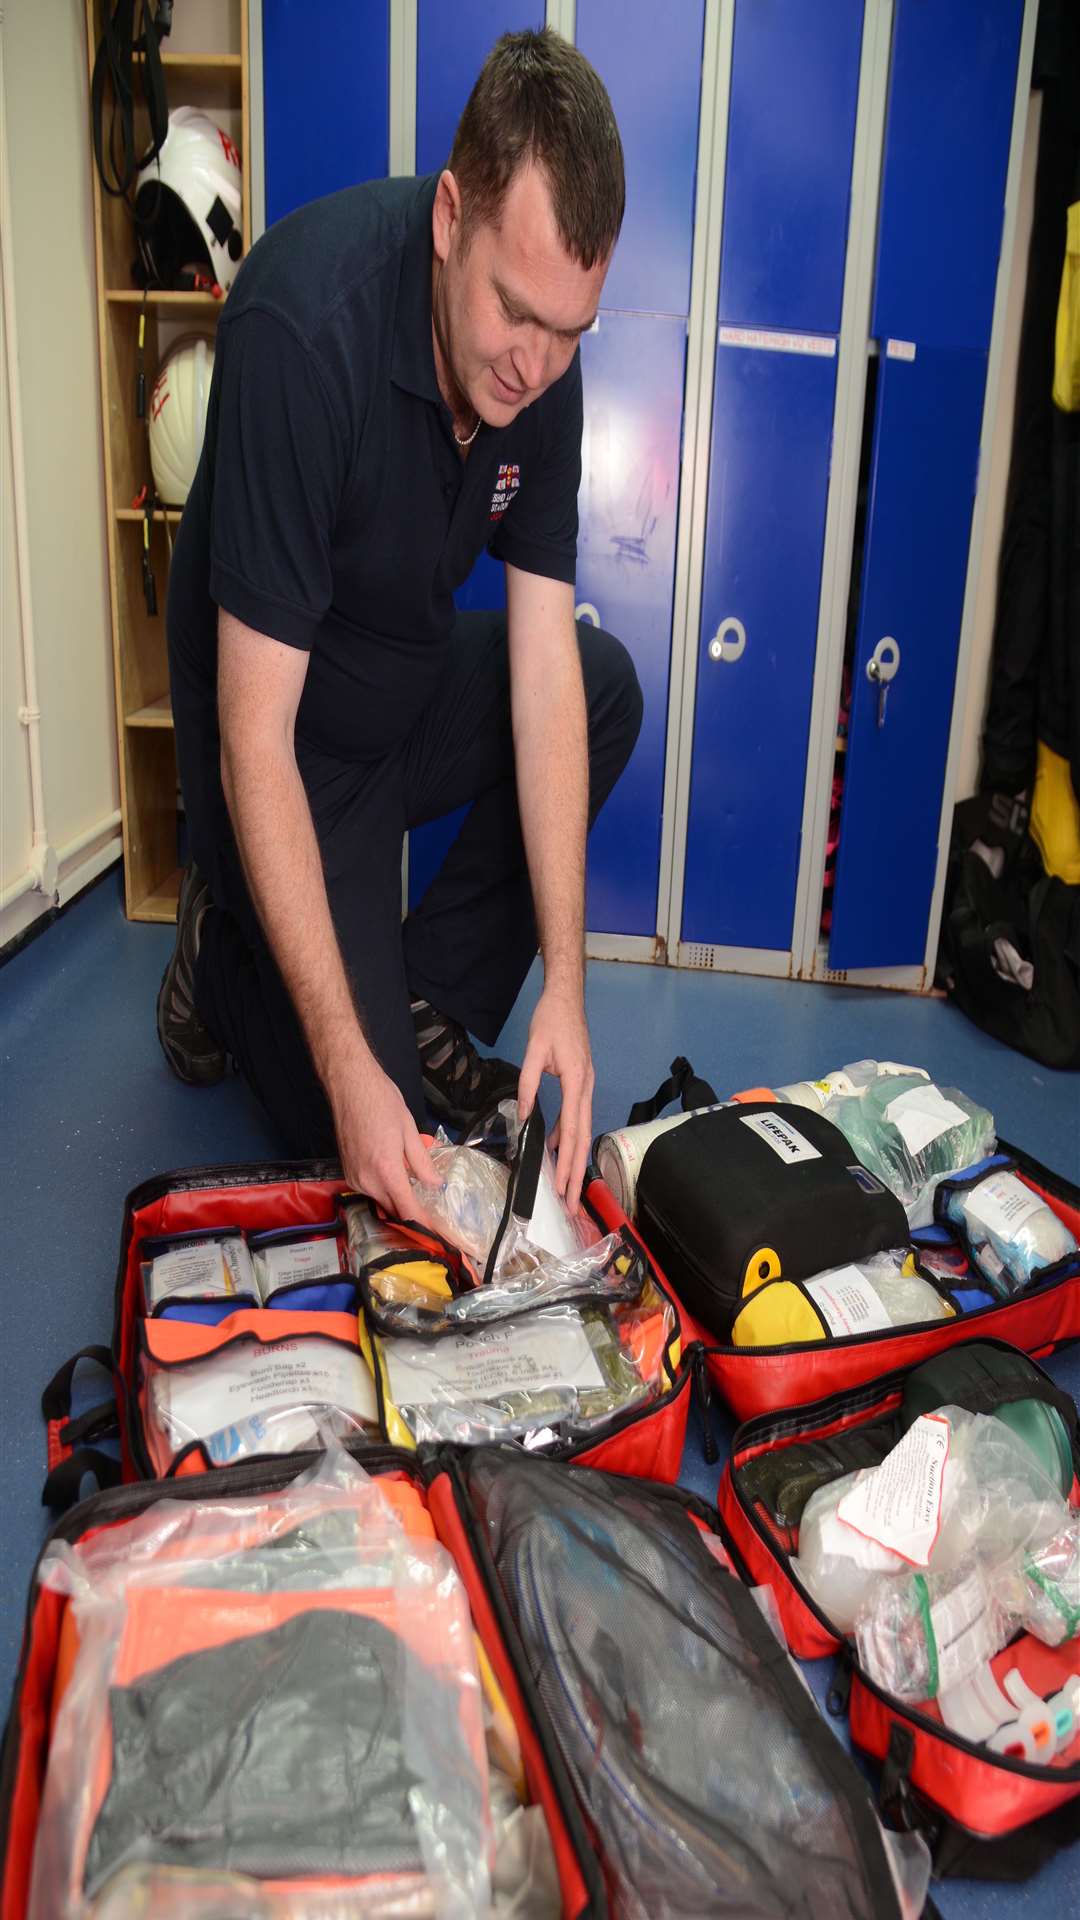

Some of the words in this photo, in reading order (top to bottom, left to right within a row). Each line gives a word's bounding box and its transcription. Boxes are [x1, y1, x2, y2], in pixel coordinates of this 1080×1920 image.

[760, 1119, 800, 1153] LIFEPAK
[254, 1343, 298, 1357] BURNS
[927, 1459, 938, 1497] Suction
